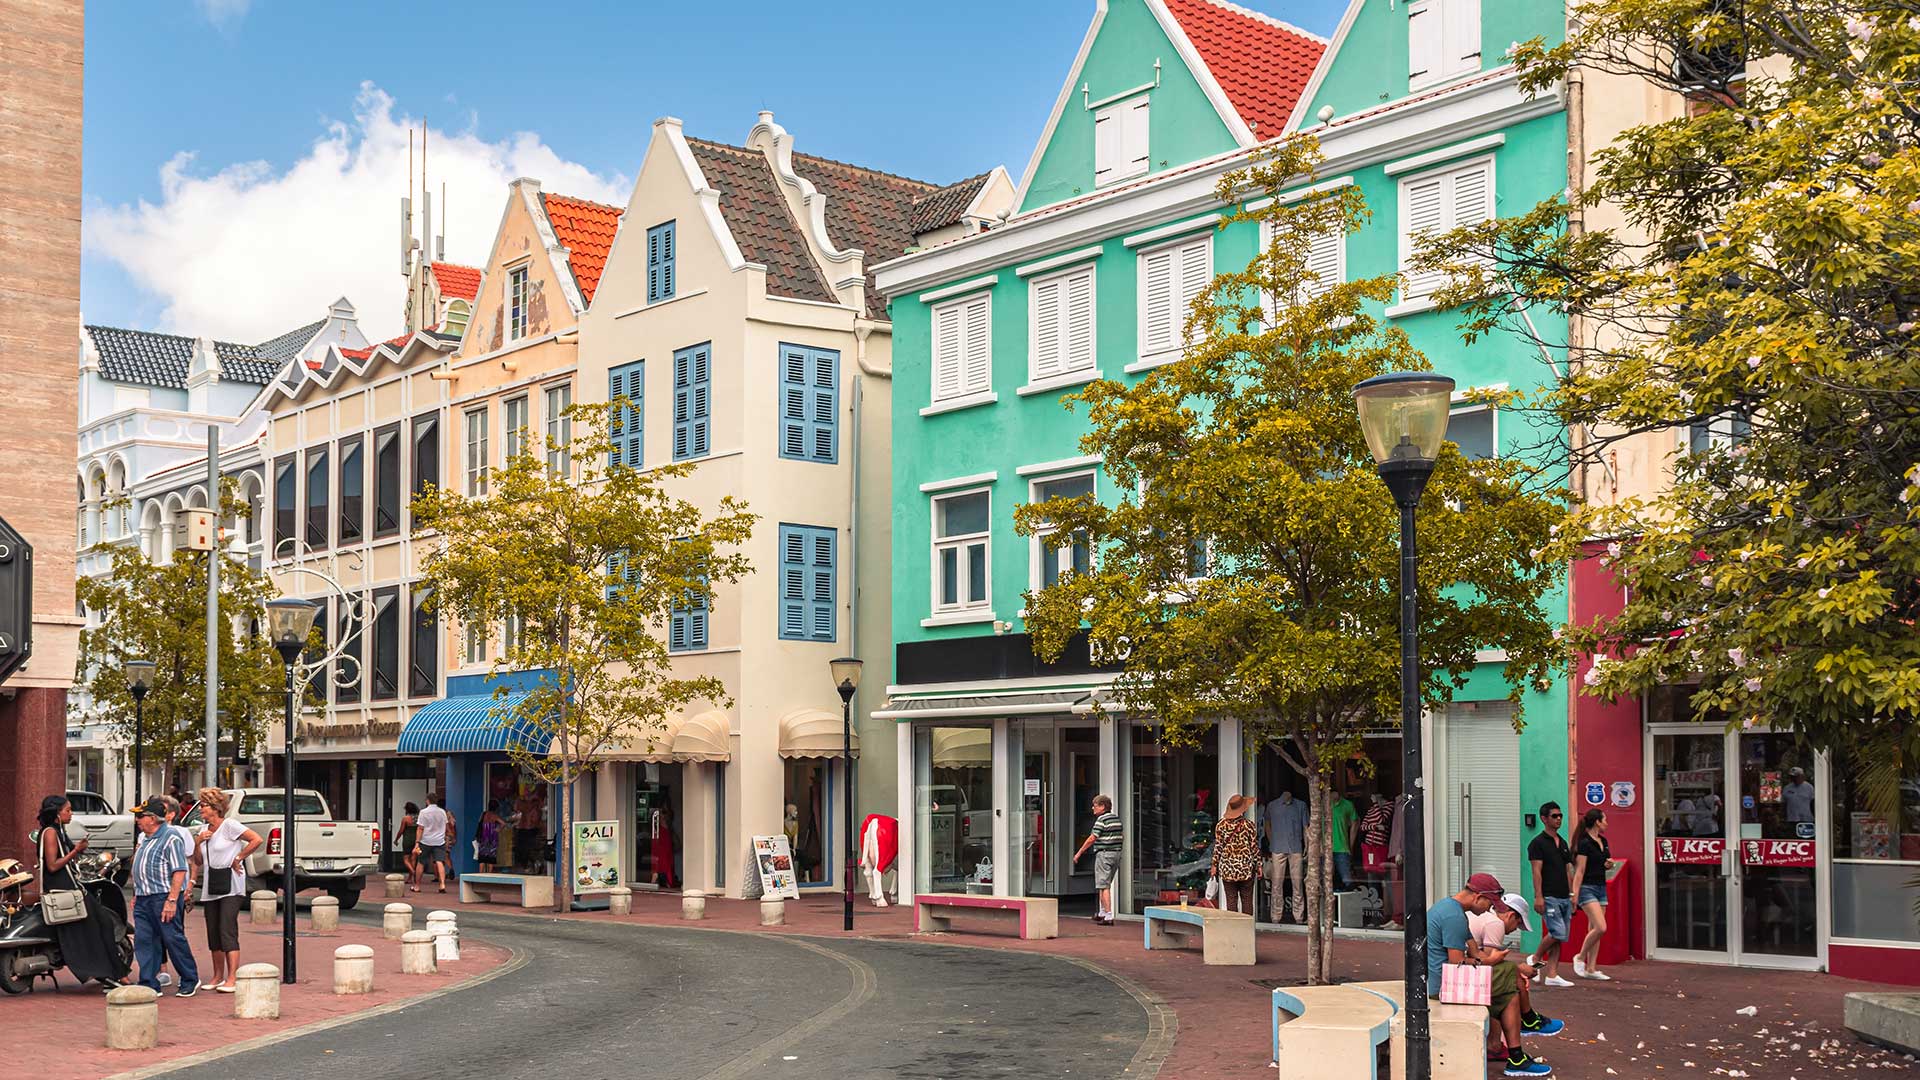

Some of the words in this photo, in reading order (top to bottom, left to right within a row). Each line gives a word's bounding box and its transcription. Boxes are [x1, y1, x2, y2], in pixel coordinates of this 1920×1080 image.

[1683, 772, 1712, 783] KFC
[580, 826, 613, 839] BALI
[1682, 840, 1720, 853] KFC
[1769, 841, 1810, 855] KFC
